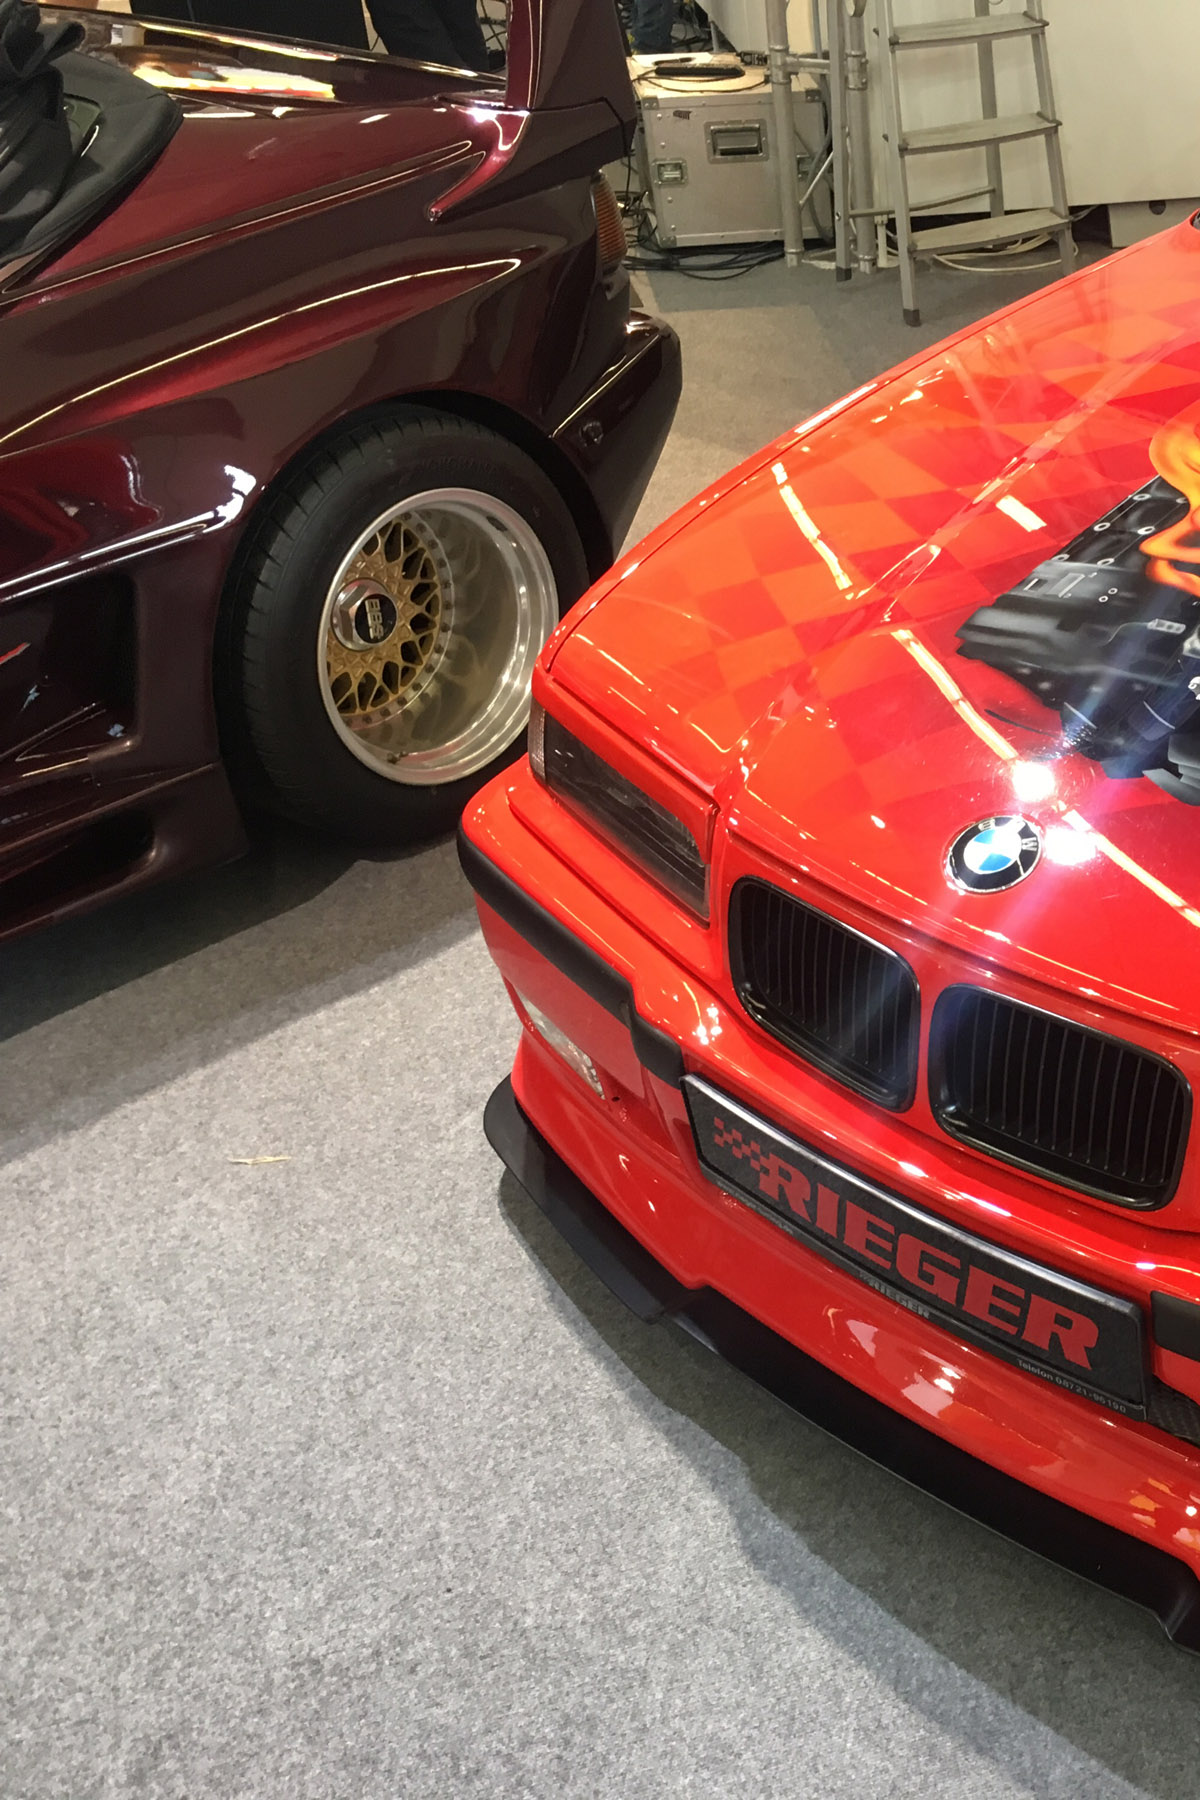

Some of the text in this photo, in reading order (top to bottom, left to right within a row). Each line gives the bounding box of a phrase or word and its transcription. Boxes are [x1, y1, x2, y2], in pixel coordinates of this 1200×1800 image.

[365, 599, 384, 639] BBS
[758, 1152, 1099, 1371] RIEGER
[1017, 1358, 1053, 1381] Telefon
